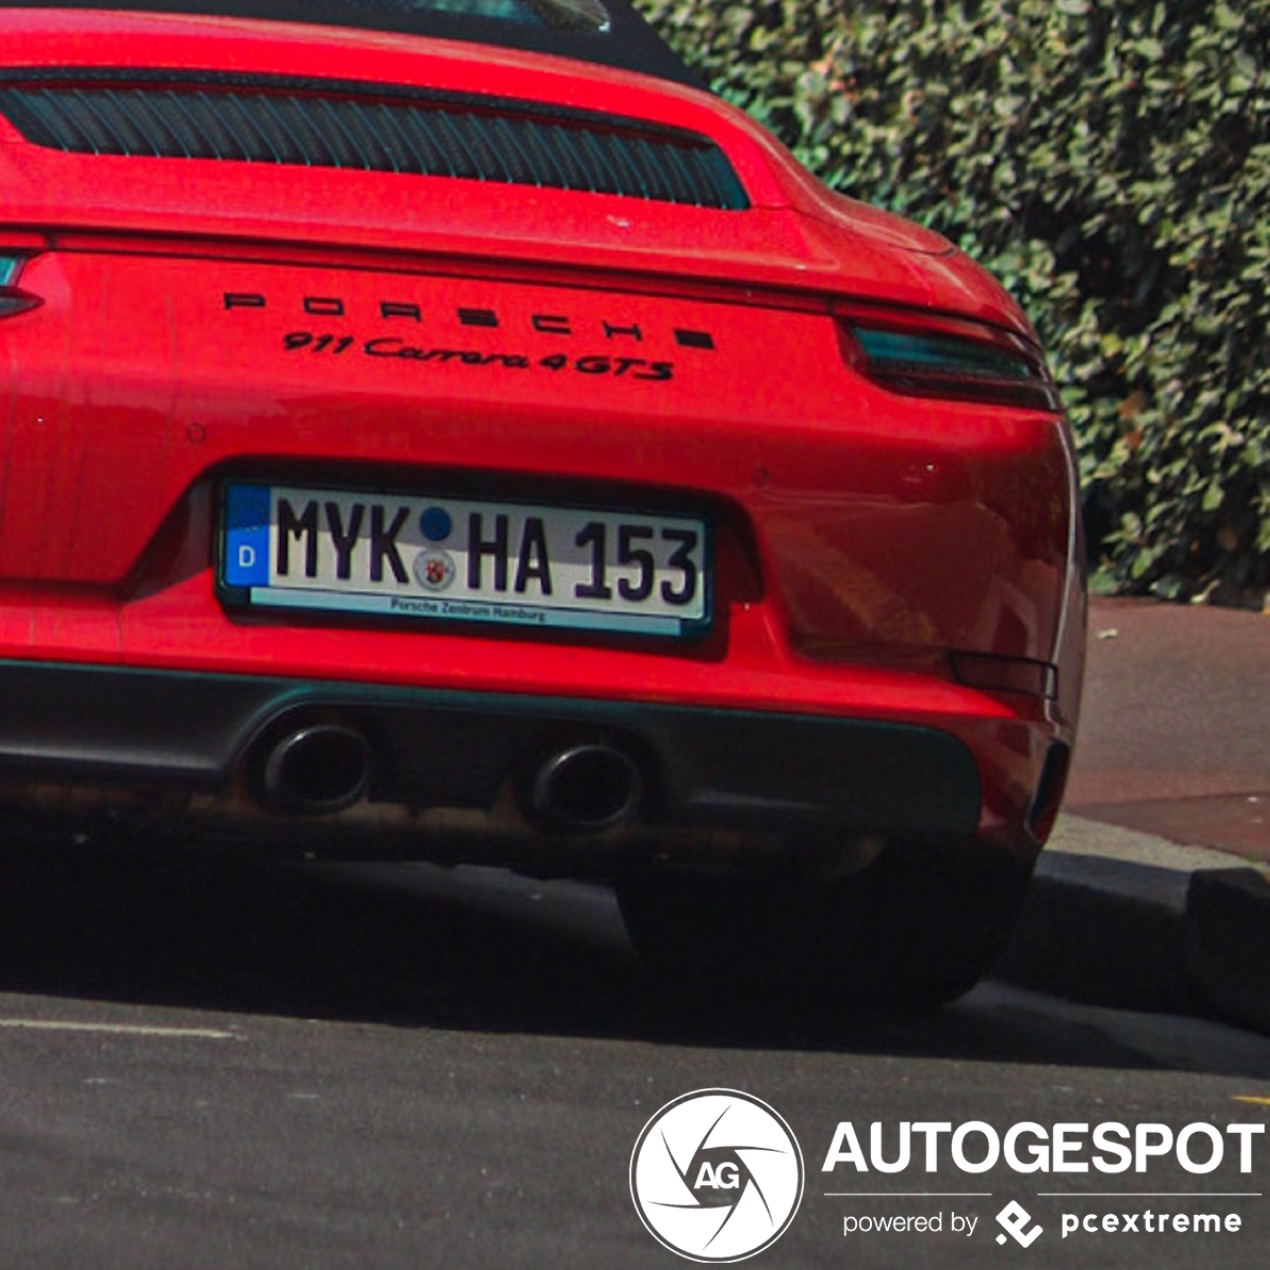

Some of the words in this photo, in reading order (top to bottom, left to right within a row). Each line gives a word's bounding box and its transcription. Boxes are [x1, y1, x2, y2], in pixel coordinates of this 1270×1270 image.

[223, 292, 715, 350] PORSCHE
[283, 332, 353, 354] 911
[363, 337, 529, 369] Carrera
[239, 545, 256, 567] D
[275, 498, 411, 584] MYK
[467, 512, 553, 596] HA
[573, 521, 698, 605] 153
[391, 596, 437, 613] Porsche
[441, 602, 490, 617] Zentrum
[493, 607, 546, 623] Hamburg
